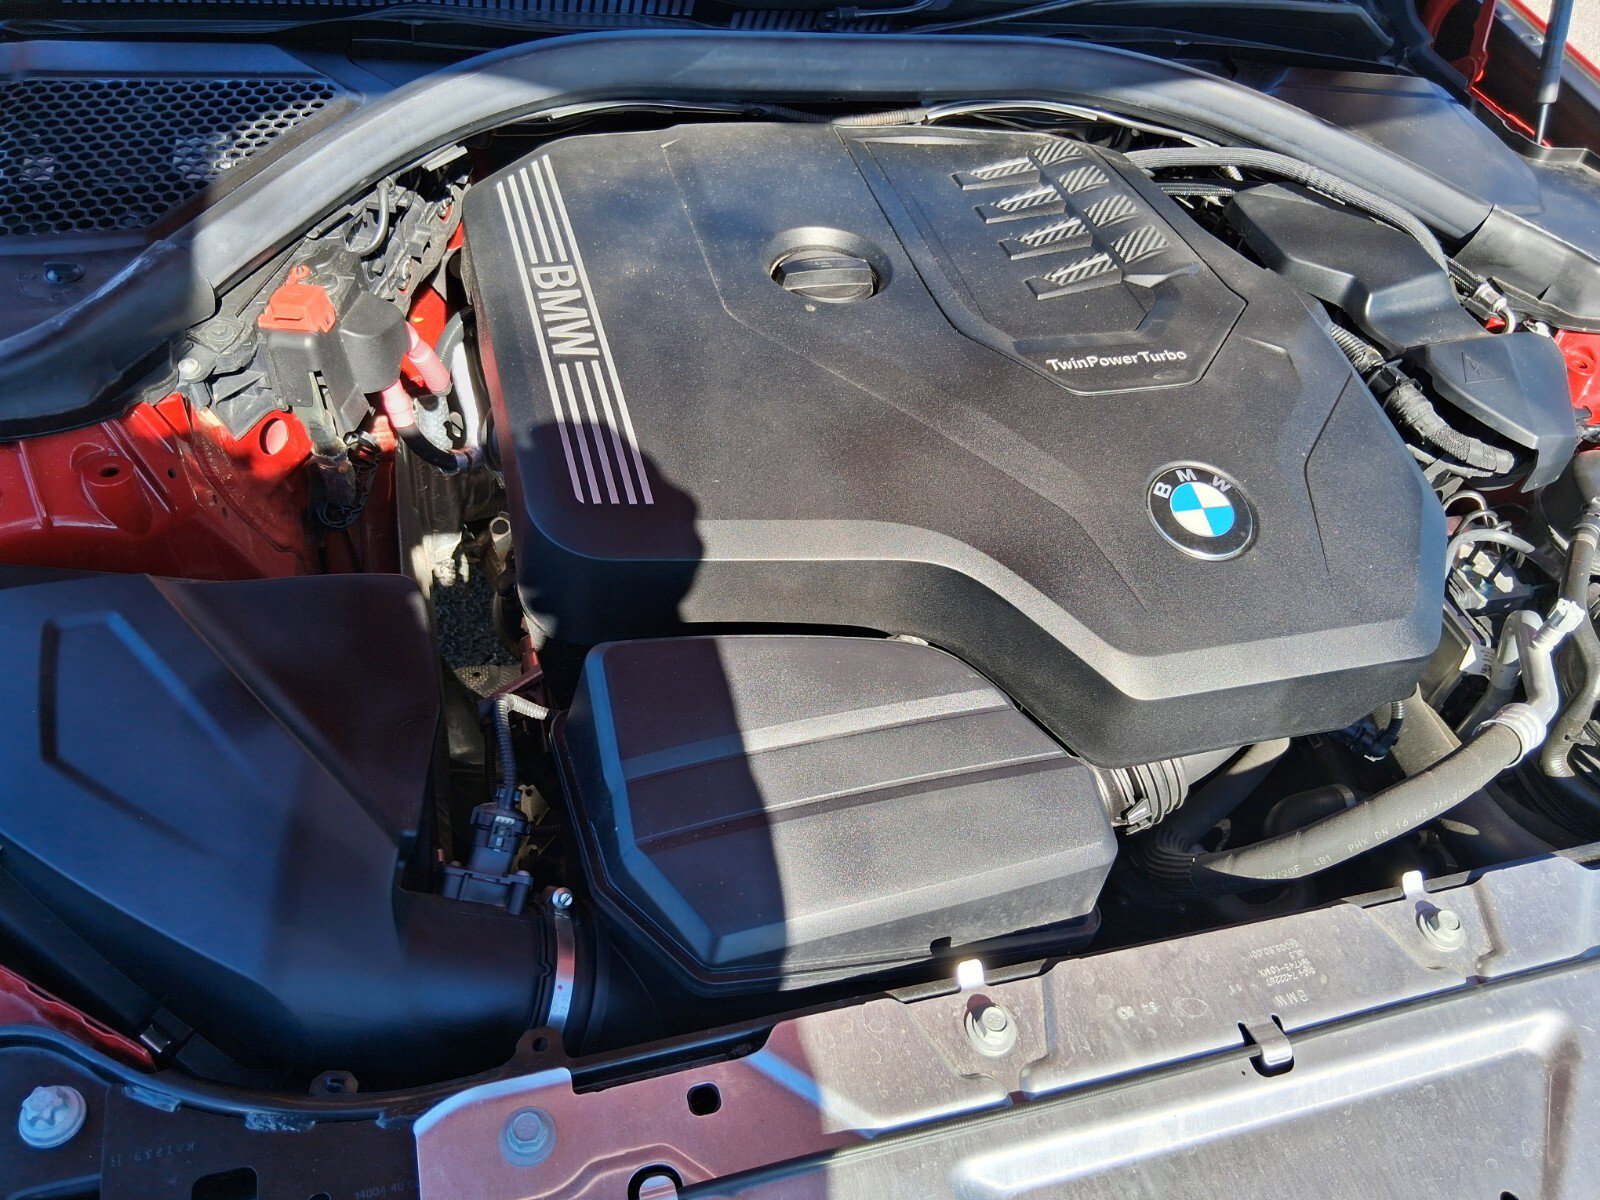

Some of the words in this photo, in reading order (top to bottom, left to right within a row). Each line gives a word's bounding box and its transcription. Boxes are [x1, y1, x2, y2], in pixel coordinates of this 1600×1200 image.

[531, 265, 600, 356] BMW
[1046, 350, 1188, 371] TwinPowerTurbo
[1153, 468, 1231, 499] BMW
[1374, 826, 1389, 840] DN
[1395, 818, 1410, 832] 16
[1272, 989, 1309, 1008] BMW
